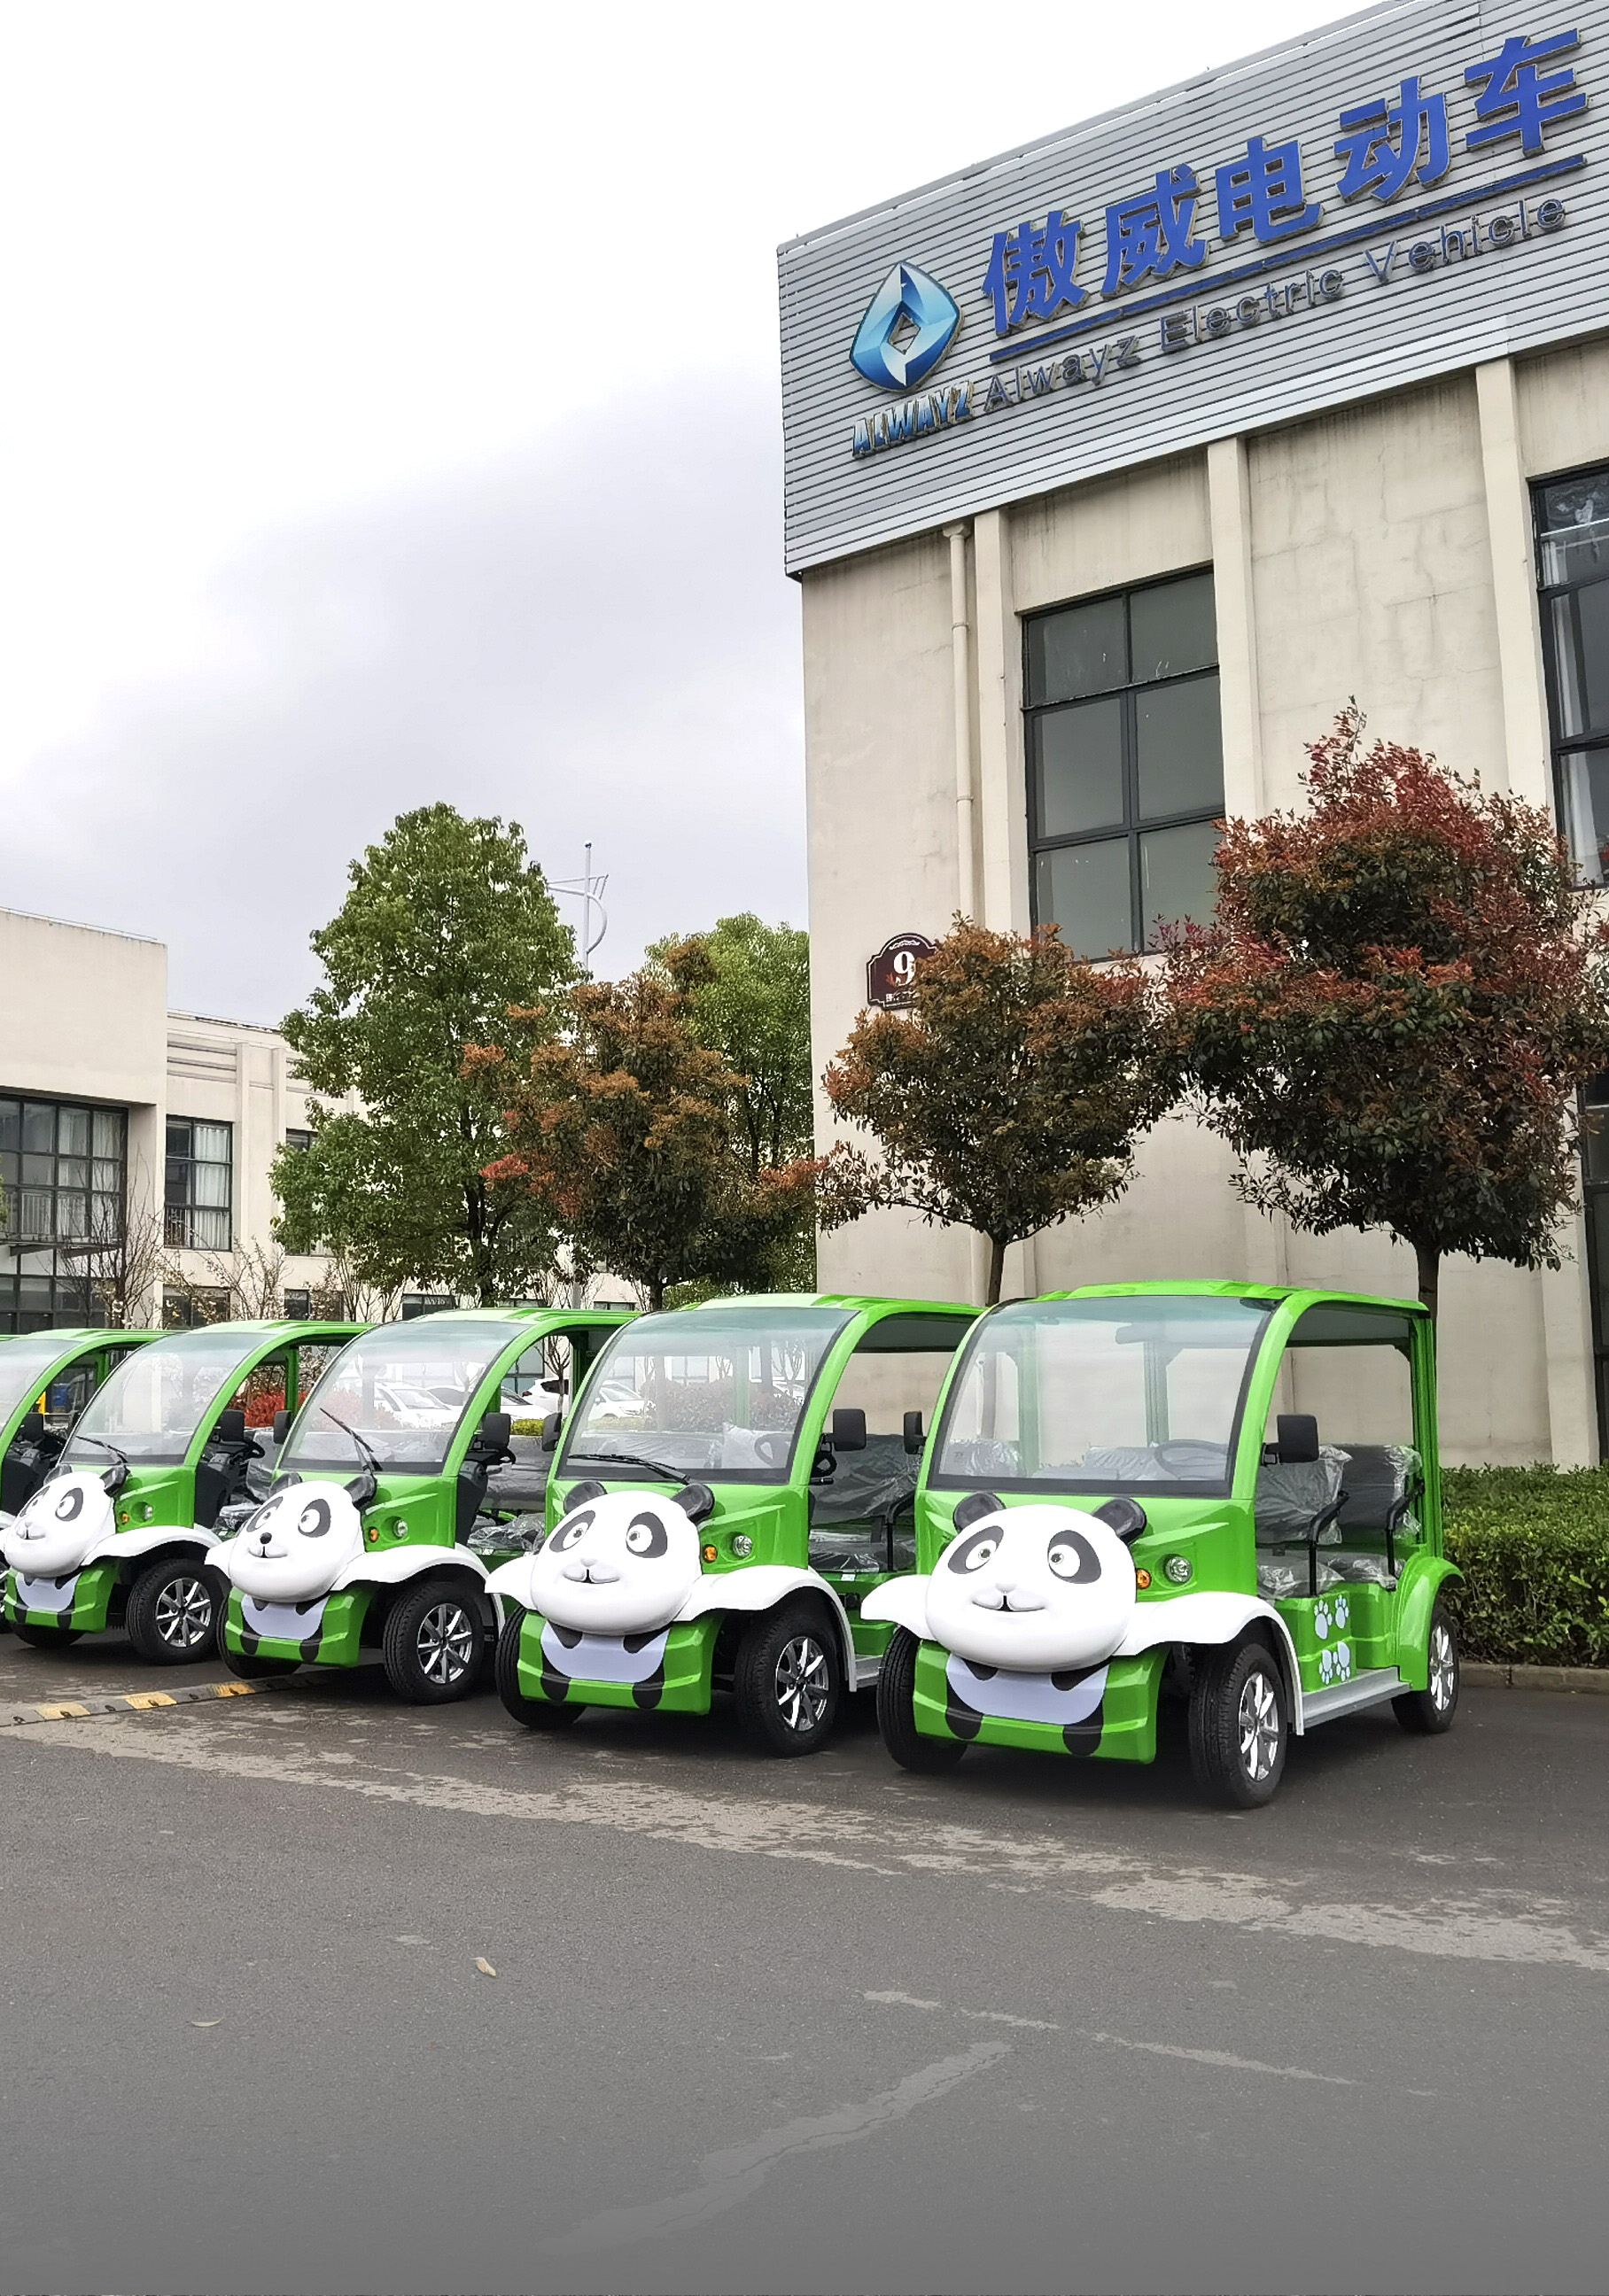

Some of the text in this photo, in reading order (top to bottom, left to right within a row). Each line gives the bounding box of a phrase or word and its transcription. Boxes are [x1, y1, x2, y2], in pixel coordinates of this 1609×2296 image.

[982, 28, 1590, 336] 傲威电动车
[983, 198, 1566, 413] Alwayz Electric Vehicle
[852, 380, 974, 458] ALWAYZ
[893, 950, 915, 987] 9
